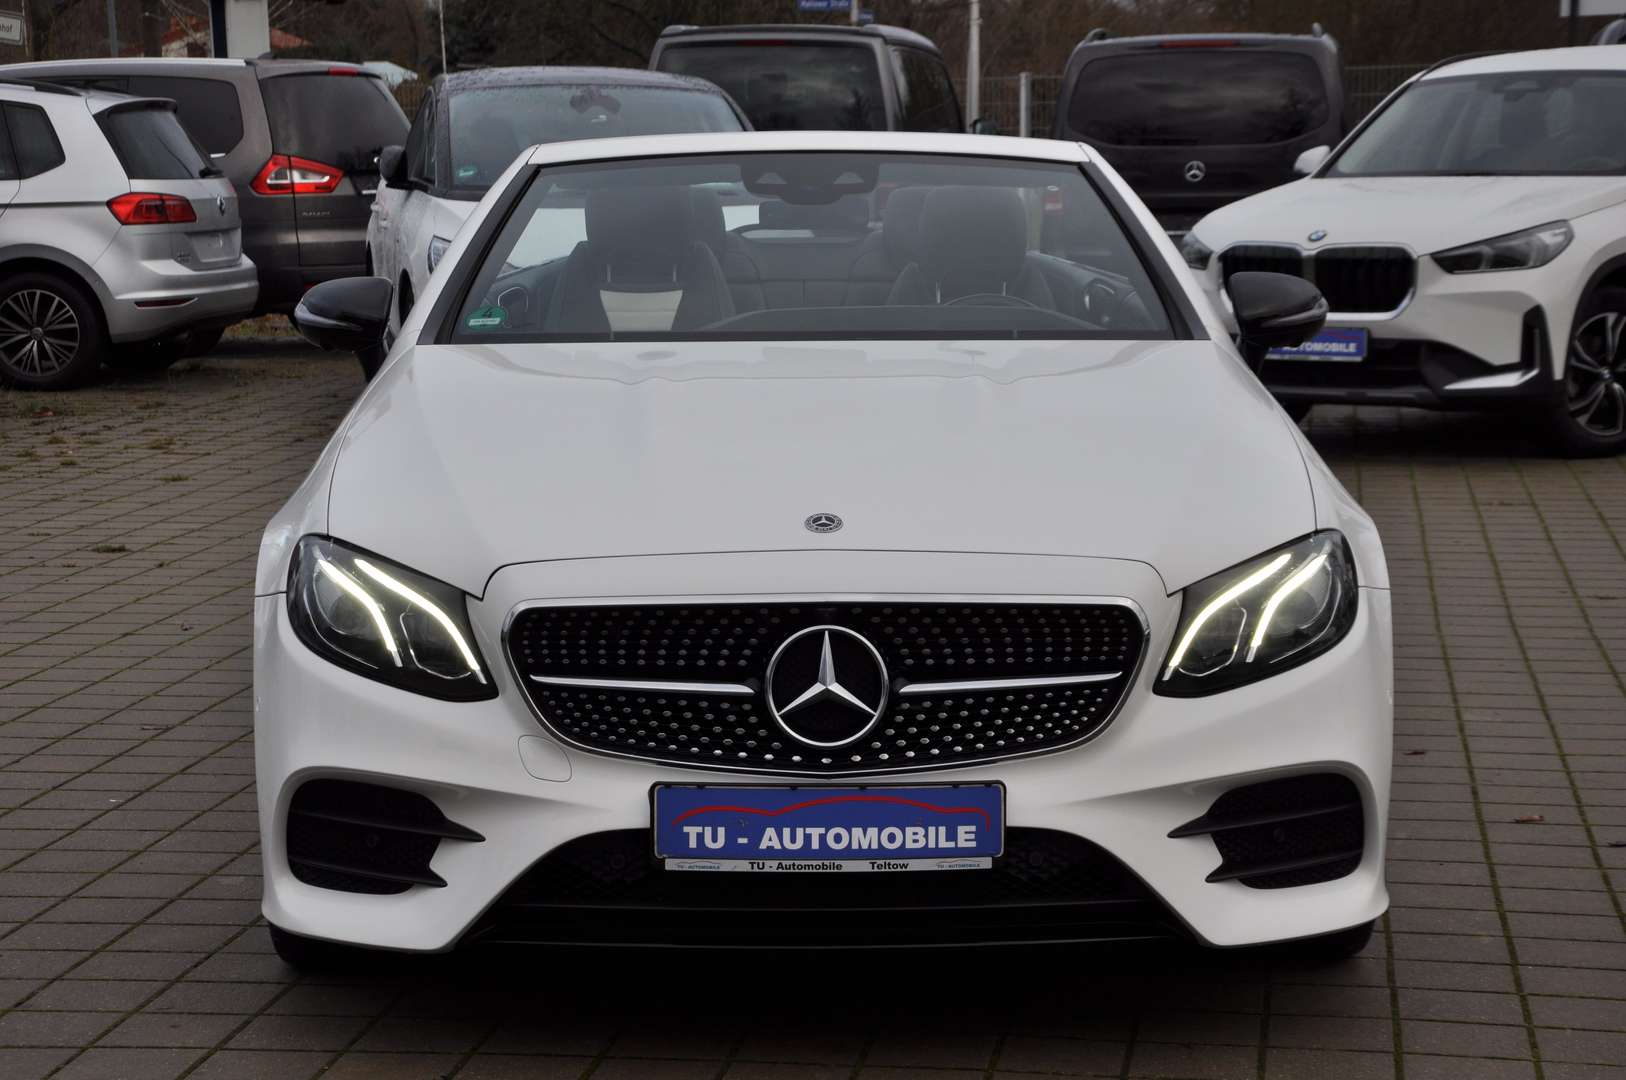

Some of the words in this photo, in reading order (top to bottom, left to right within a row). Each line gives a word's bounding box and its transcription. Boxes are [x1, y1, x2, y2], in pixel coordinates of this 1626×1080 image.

[683, 826, 725, 849] TU
[759, 825, 977, 850] AUTOMOBILE
[749, 861, 766, 871] TU
[776, 861, 843, 871] Automobile
[869, 861, 909, 870] Teltow
